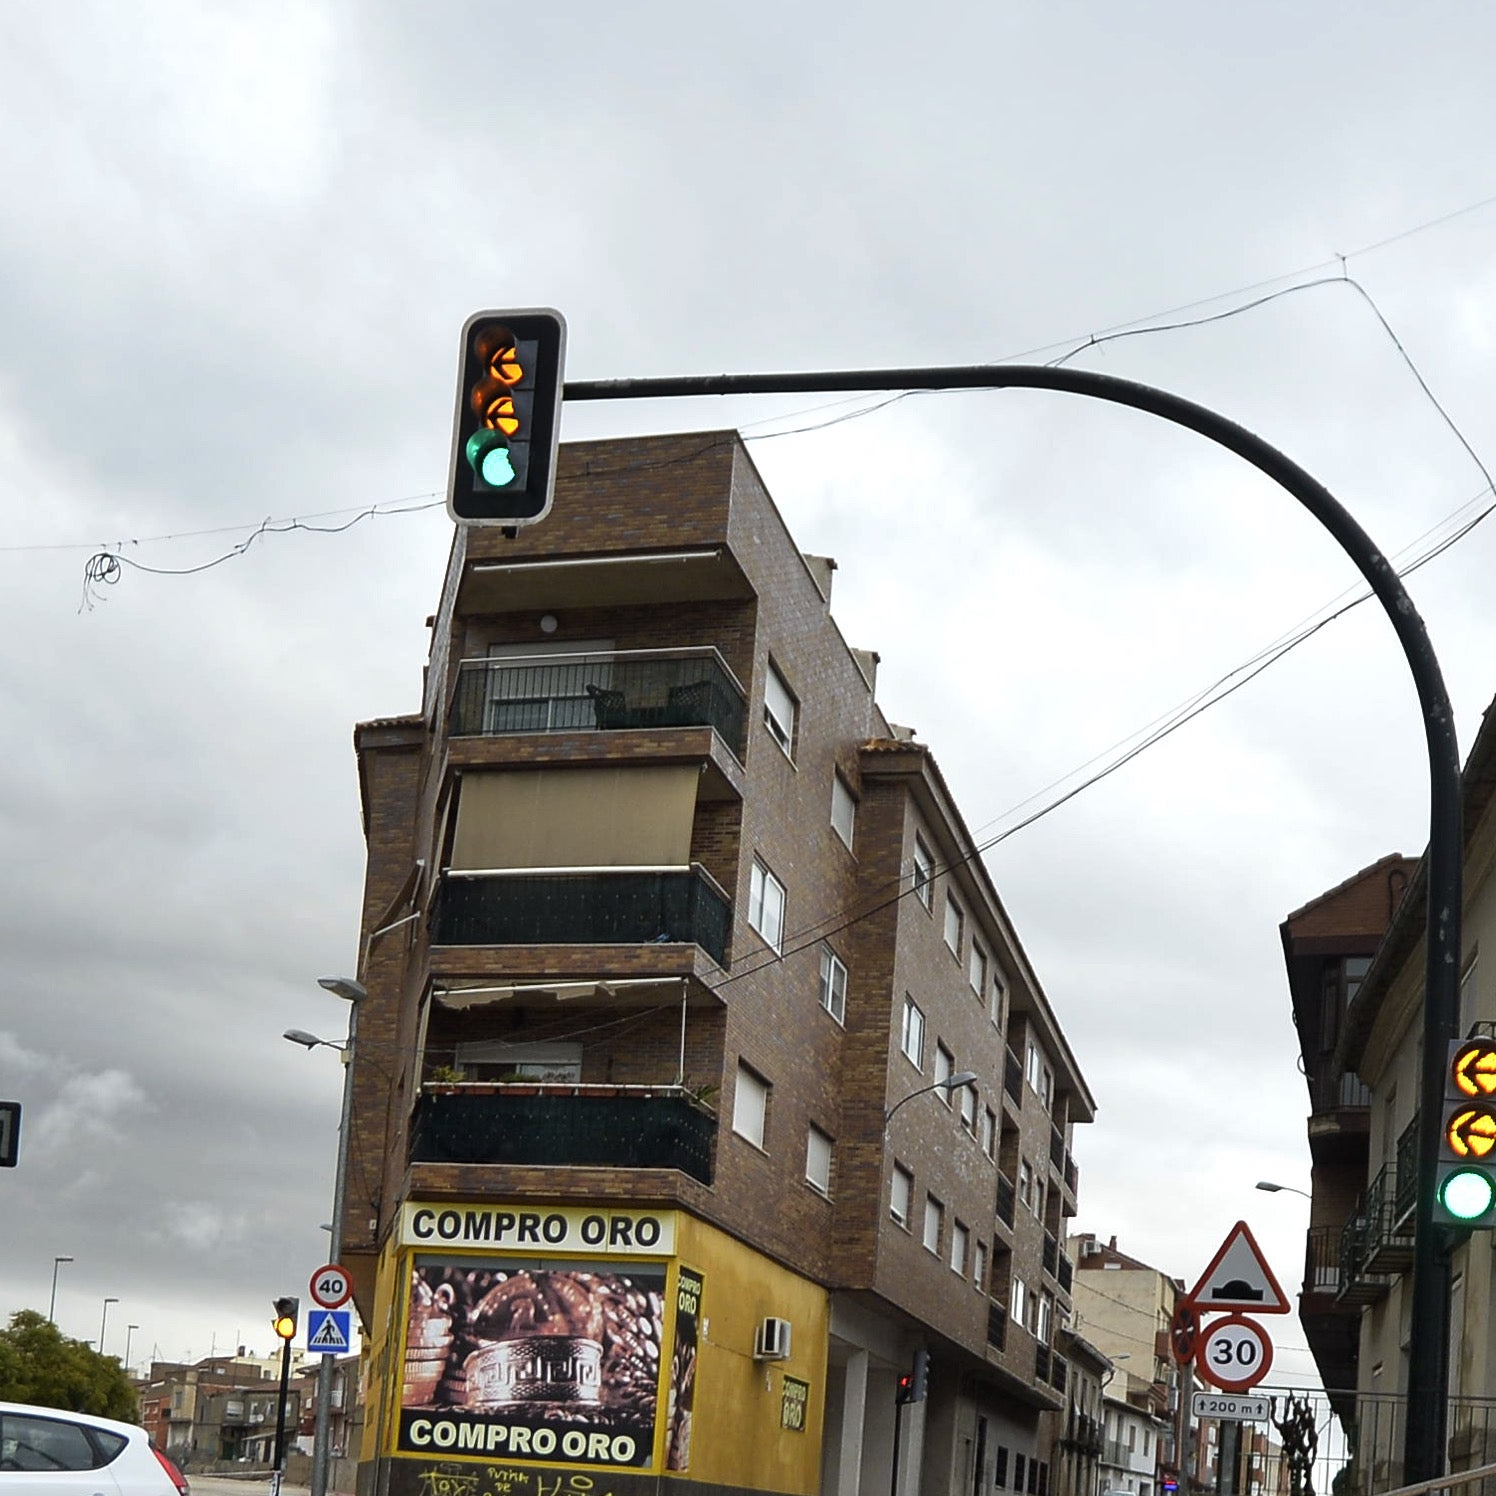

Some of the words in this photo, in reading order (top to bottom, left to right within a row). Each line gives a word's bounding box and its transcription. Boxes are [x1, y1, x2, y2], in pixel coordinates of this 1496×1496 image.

[412, 1209, 569, 1244] COMPRO
[580, 1215, 661, 1247] ORO
[319, 1279, 343, 1294] 40
[678, 1291, 697, 1315] ORO
[1212, 1338, 1256, 1366] 30
[783, 1402, 803, 1429] ORO
[1209, 1401, 1237, 1413] 200
[1241, 1405, 1252, 1414] m
[409, 1418, 557, 1455] COMPRO
[562, 1431, 636, 1462] ORO
